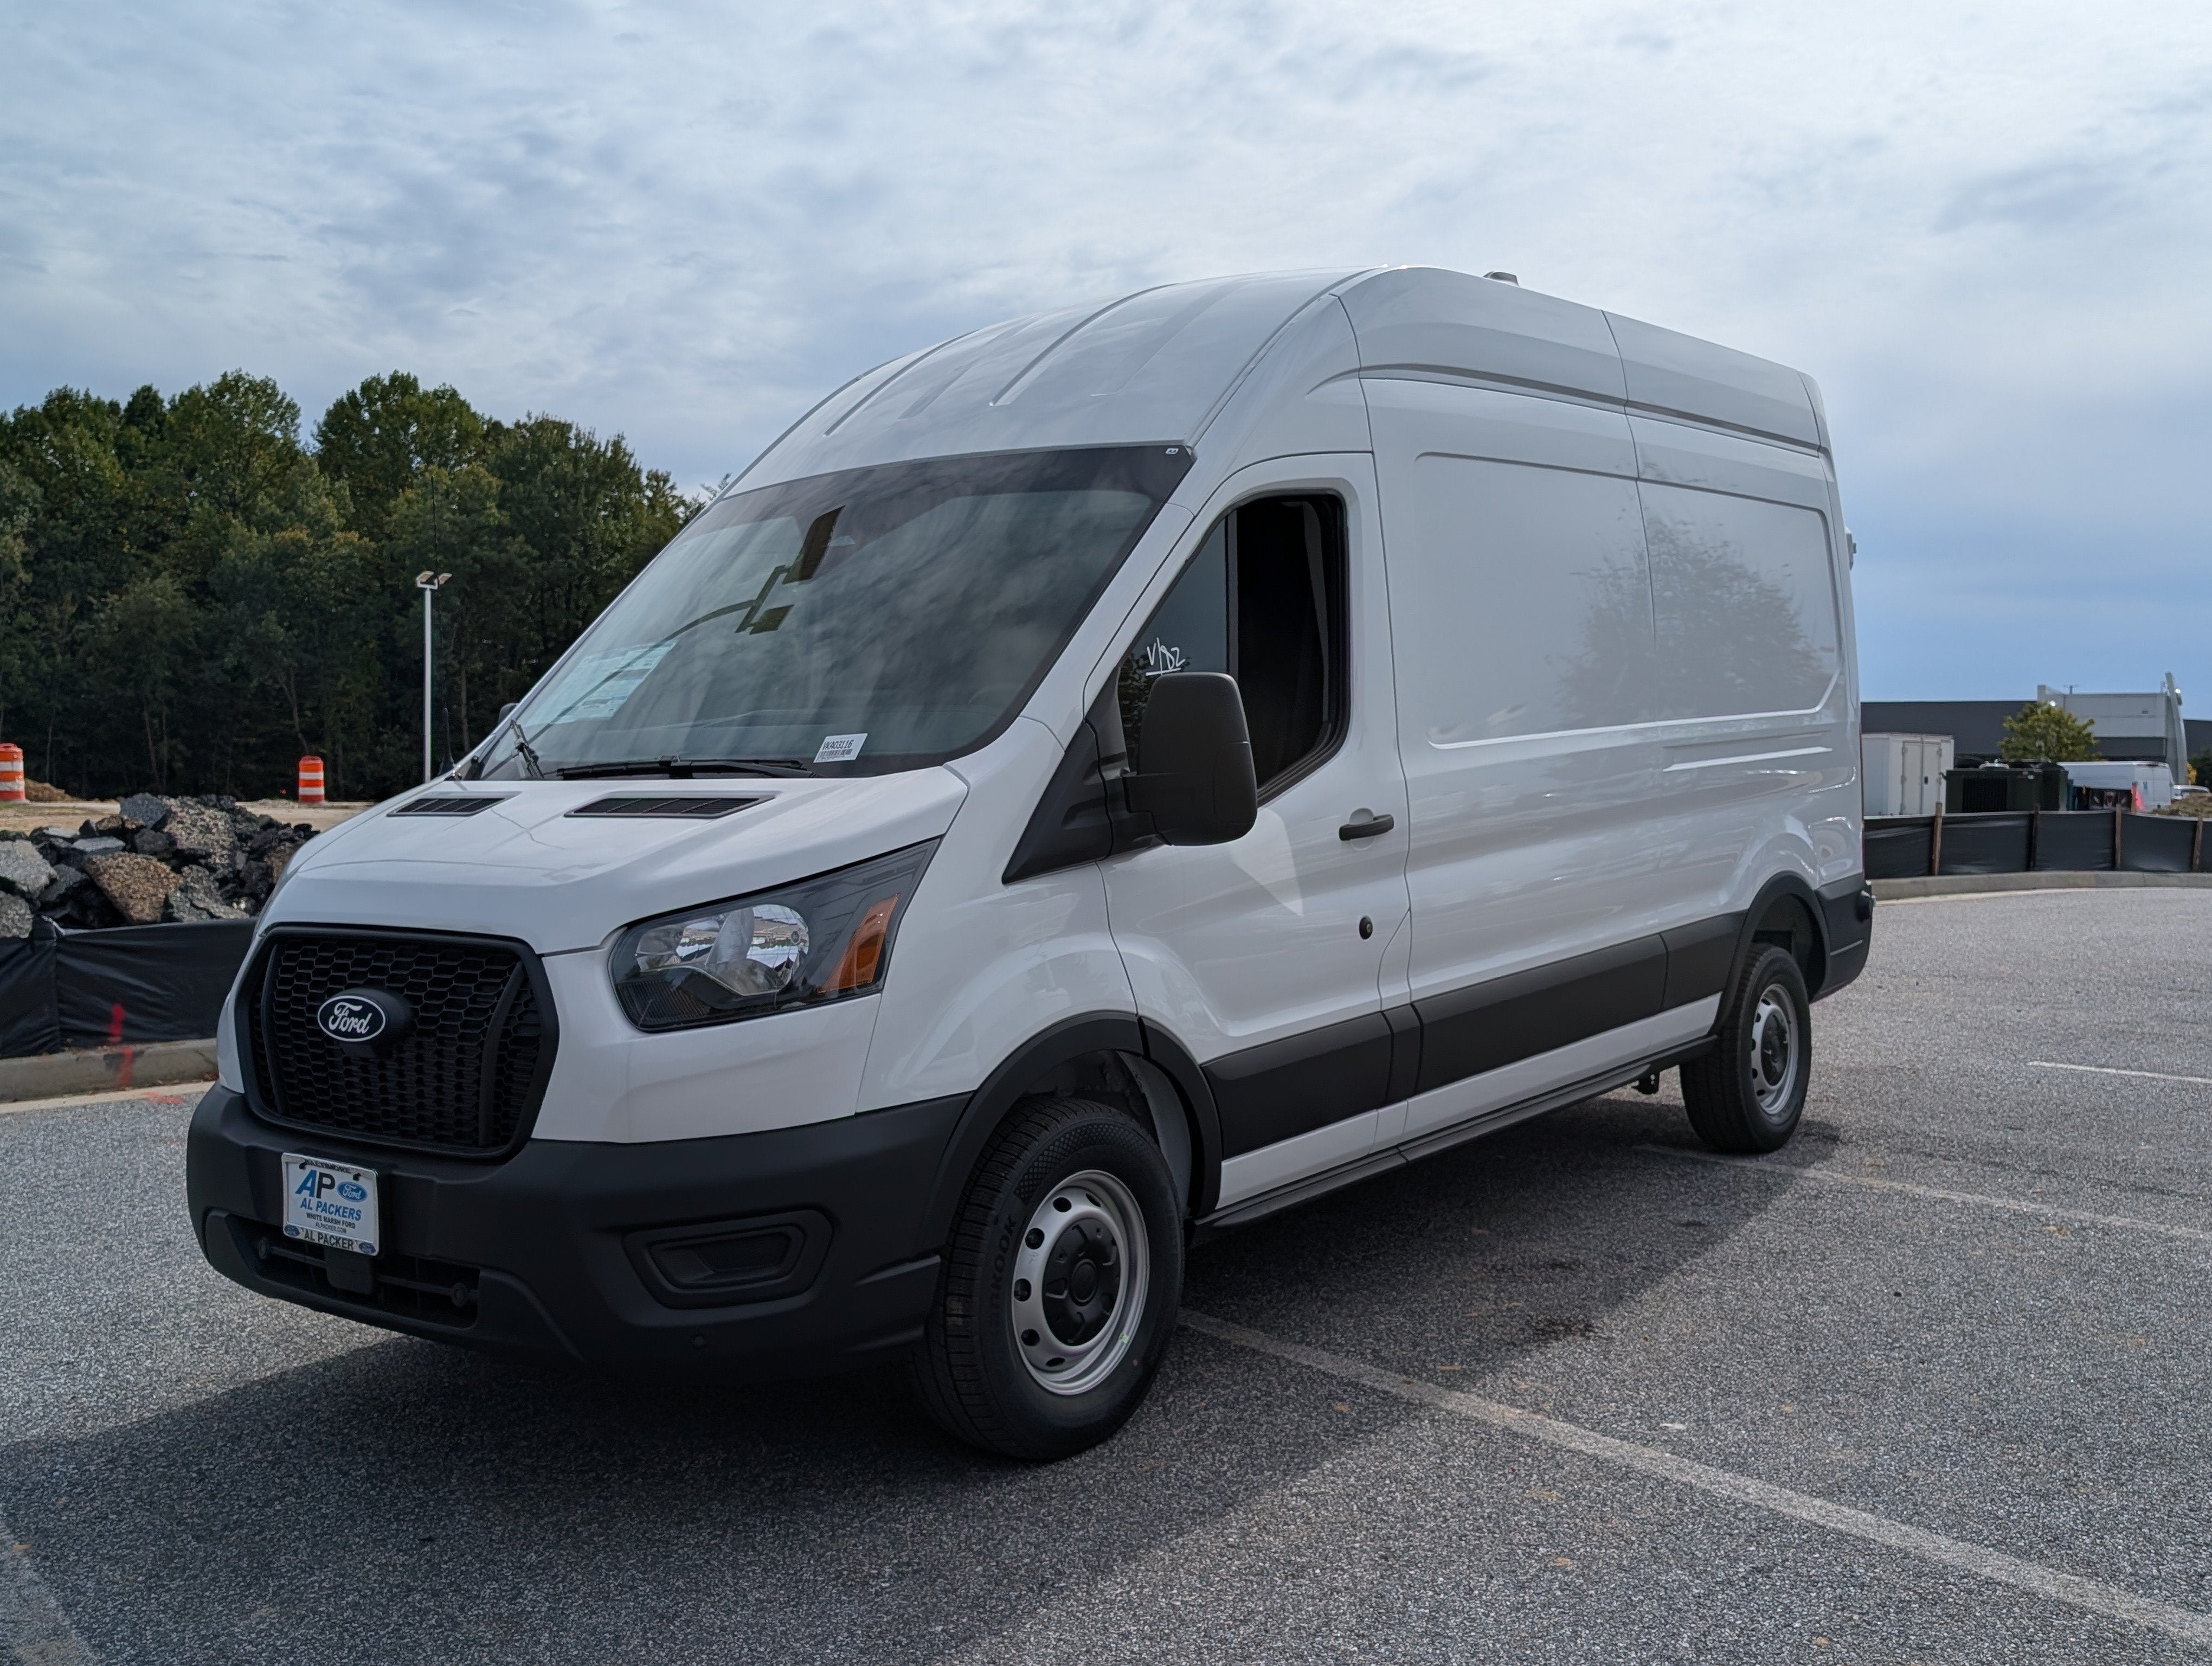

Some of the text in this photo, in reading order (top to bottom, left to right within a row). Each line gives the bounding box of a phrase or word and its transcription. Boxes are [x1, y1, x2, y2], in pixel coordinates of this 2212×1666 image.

[329, 1002, 372, 1034] Ford
[295, 1169, 336, 1199] AP
[300, 1197, 362, 1221] AL PACKERS
[306, 1212, 356, 1229] WHITE MARSH FORD
[315, 1222, 347, 1234] ALPACKER.COM
[304, 1229, 315, 1241] AL
[318, 1232, 353, 1251] PACKER
